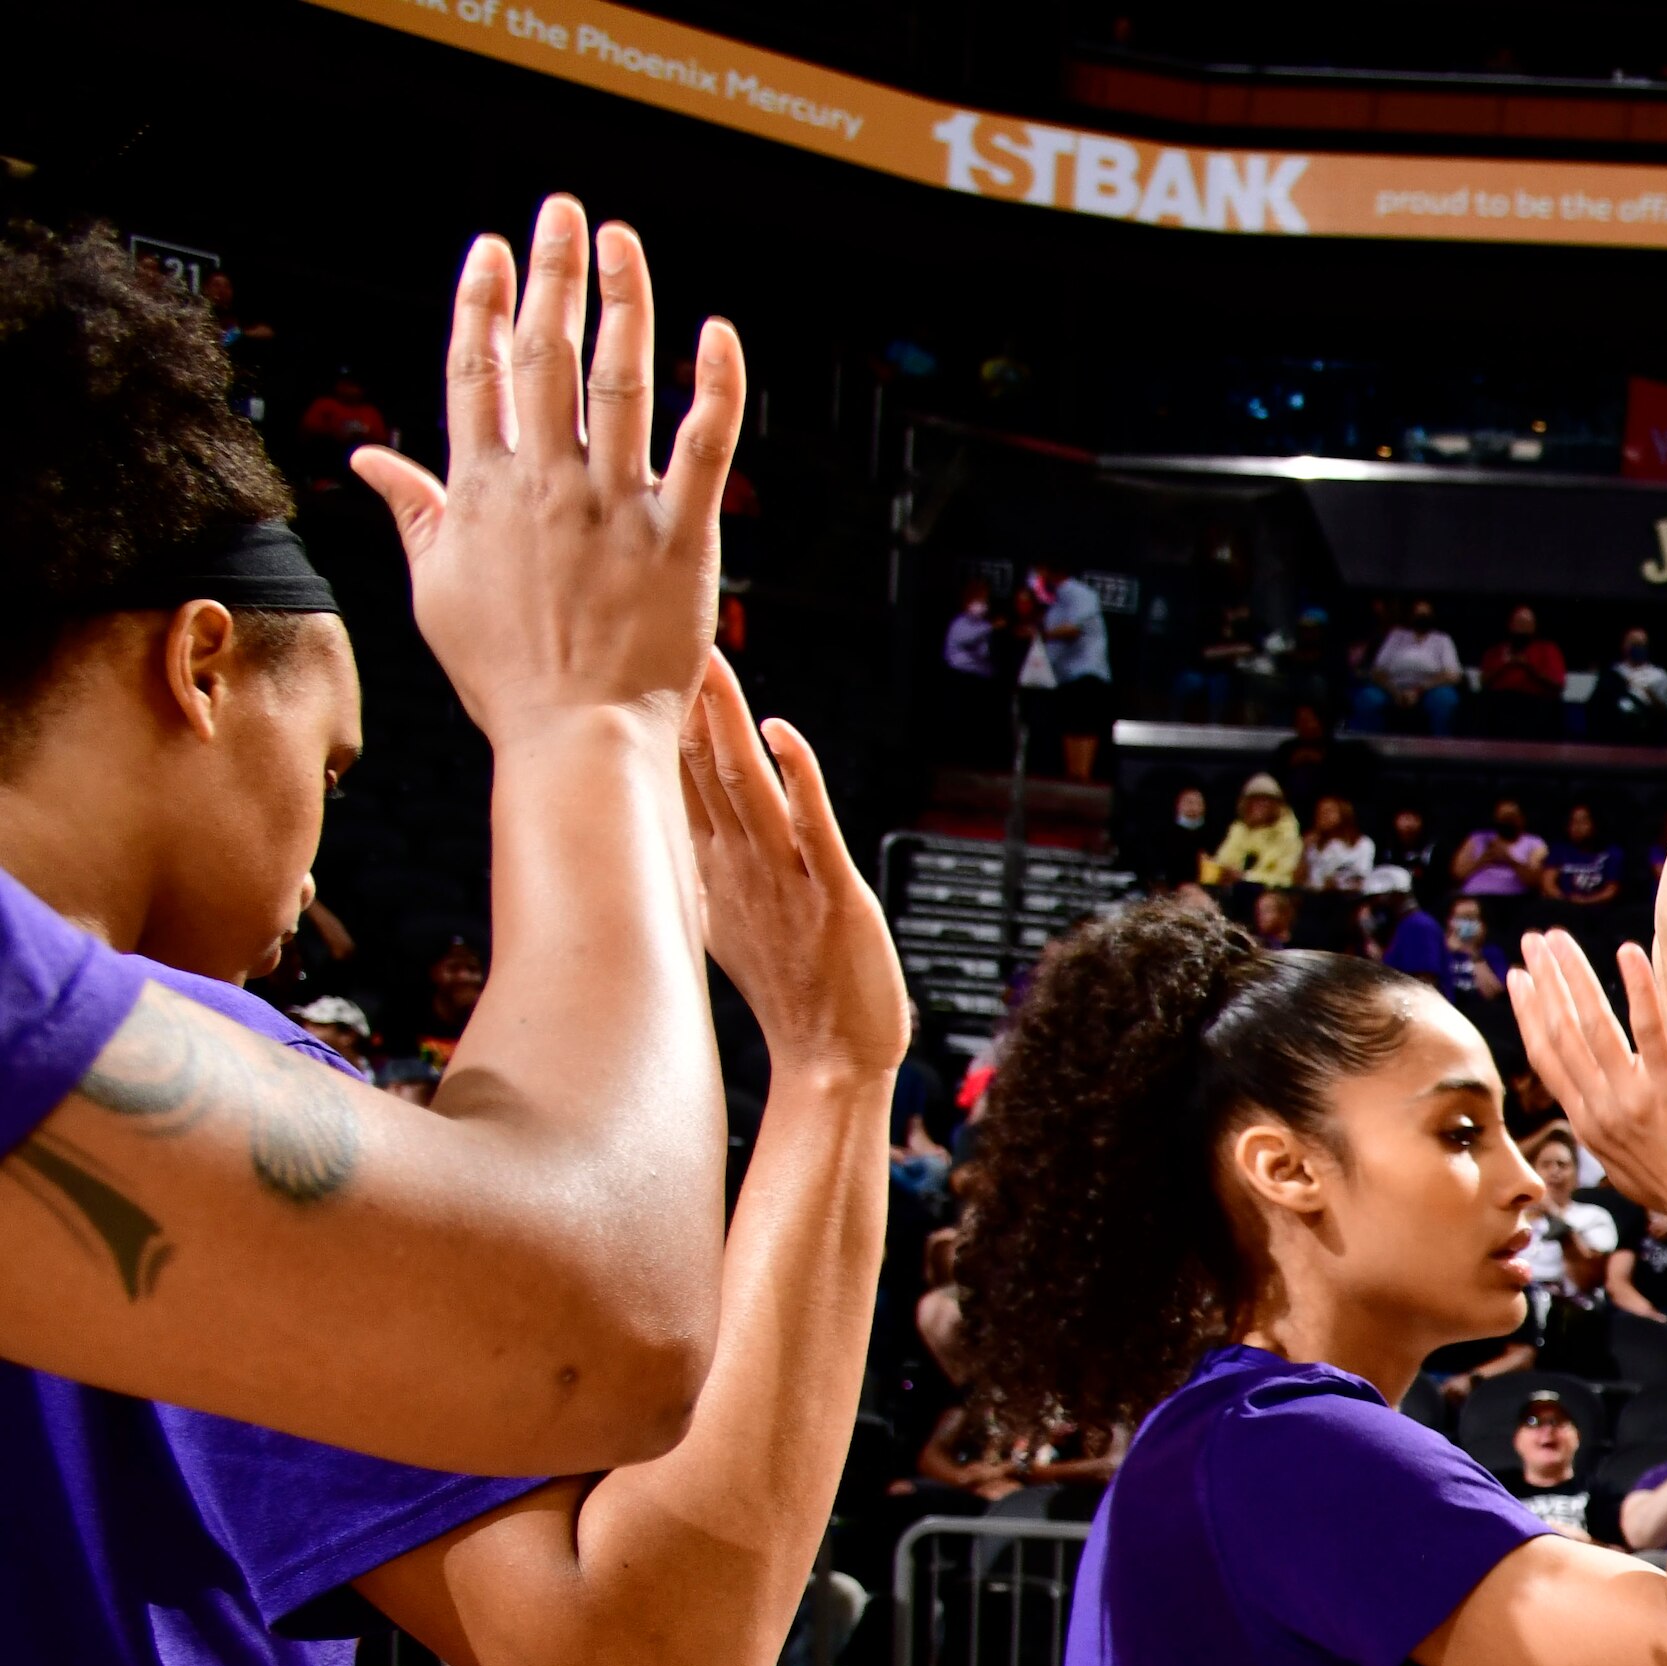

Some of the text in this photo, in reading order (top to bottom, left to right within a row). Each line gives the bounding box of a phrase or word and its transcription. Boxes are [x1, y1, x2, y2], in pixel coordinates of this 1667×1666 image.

[457, 0, 864, 141] of the Phoenix Mercury
[1376, 187, 1470, 217] proud
[1474, 190, 1511, 218] to
[1515, 188, 1554, 220] be
[1559, 192, 1612, 222] the
